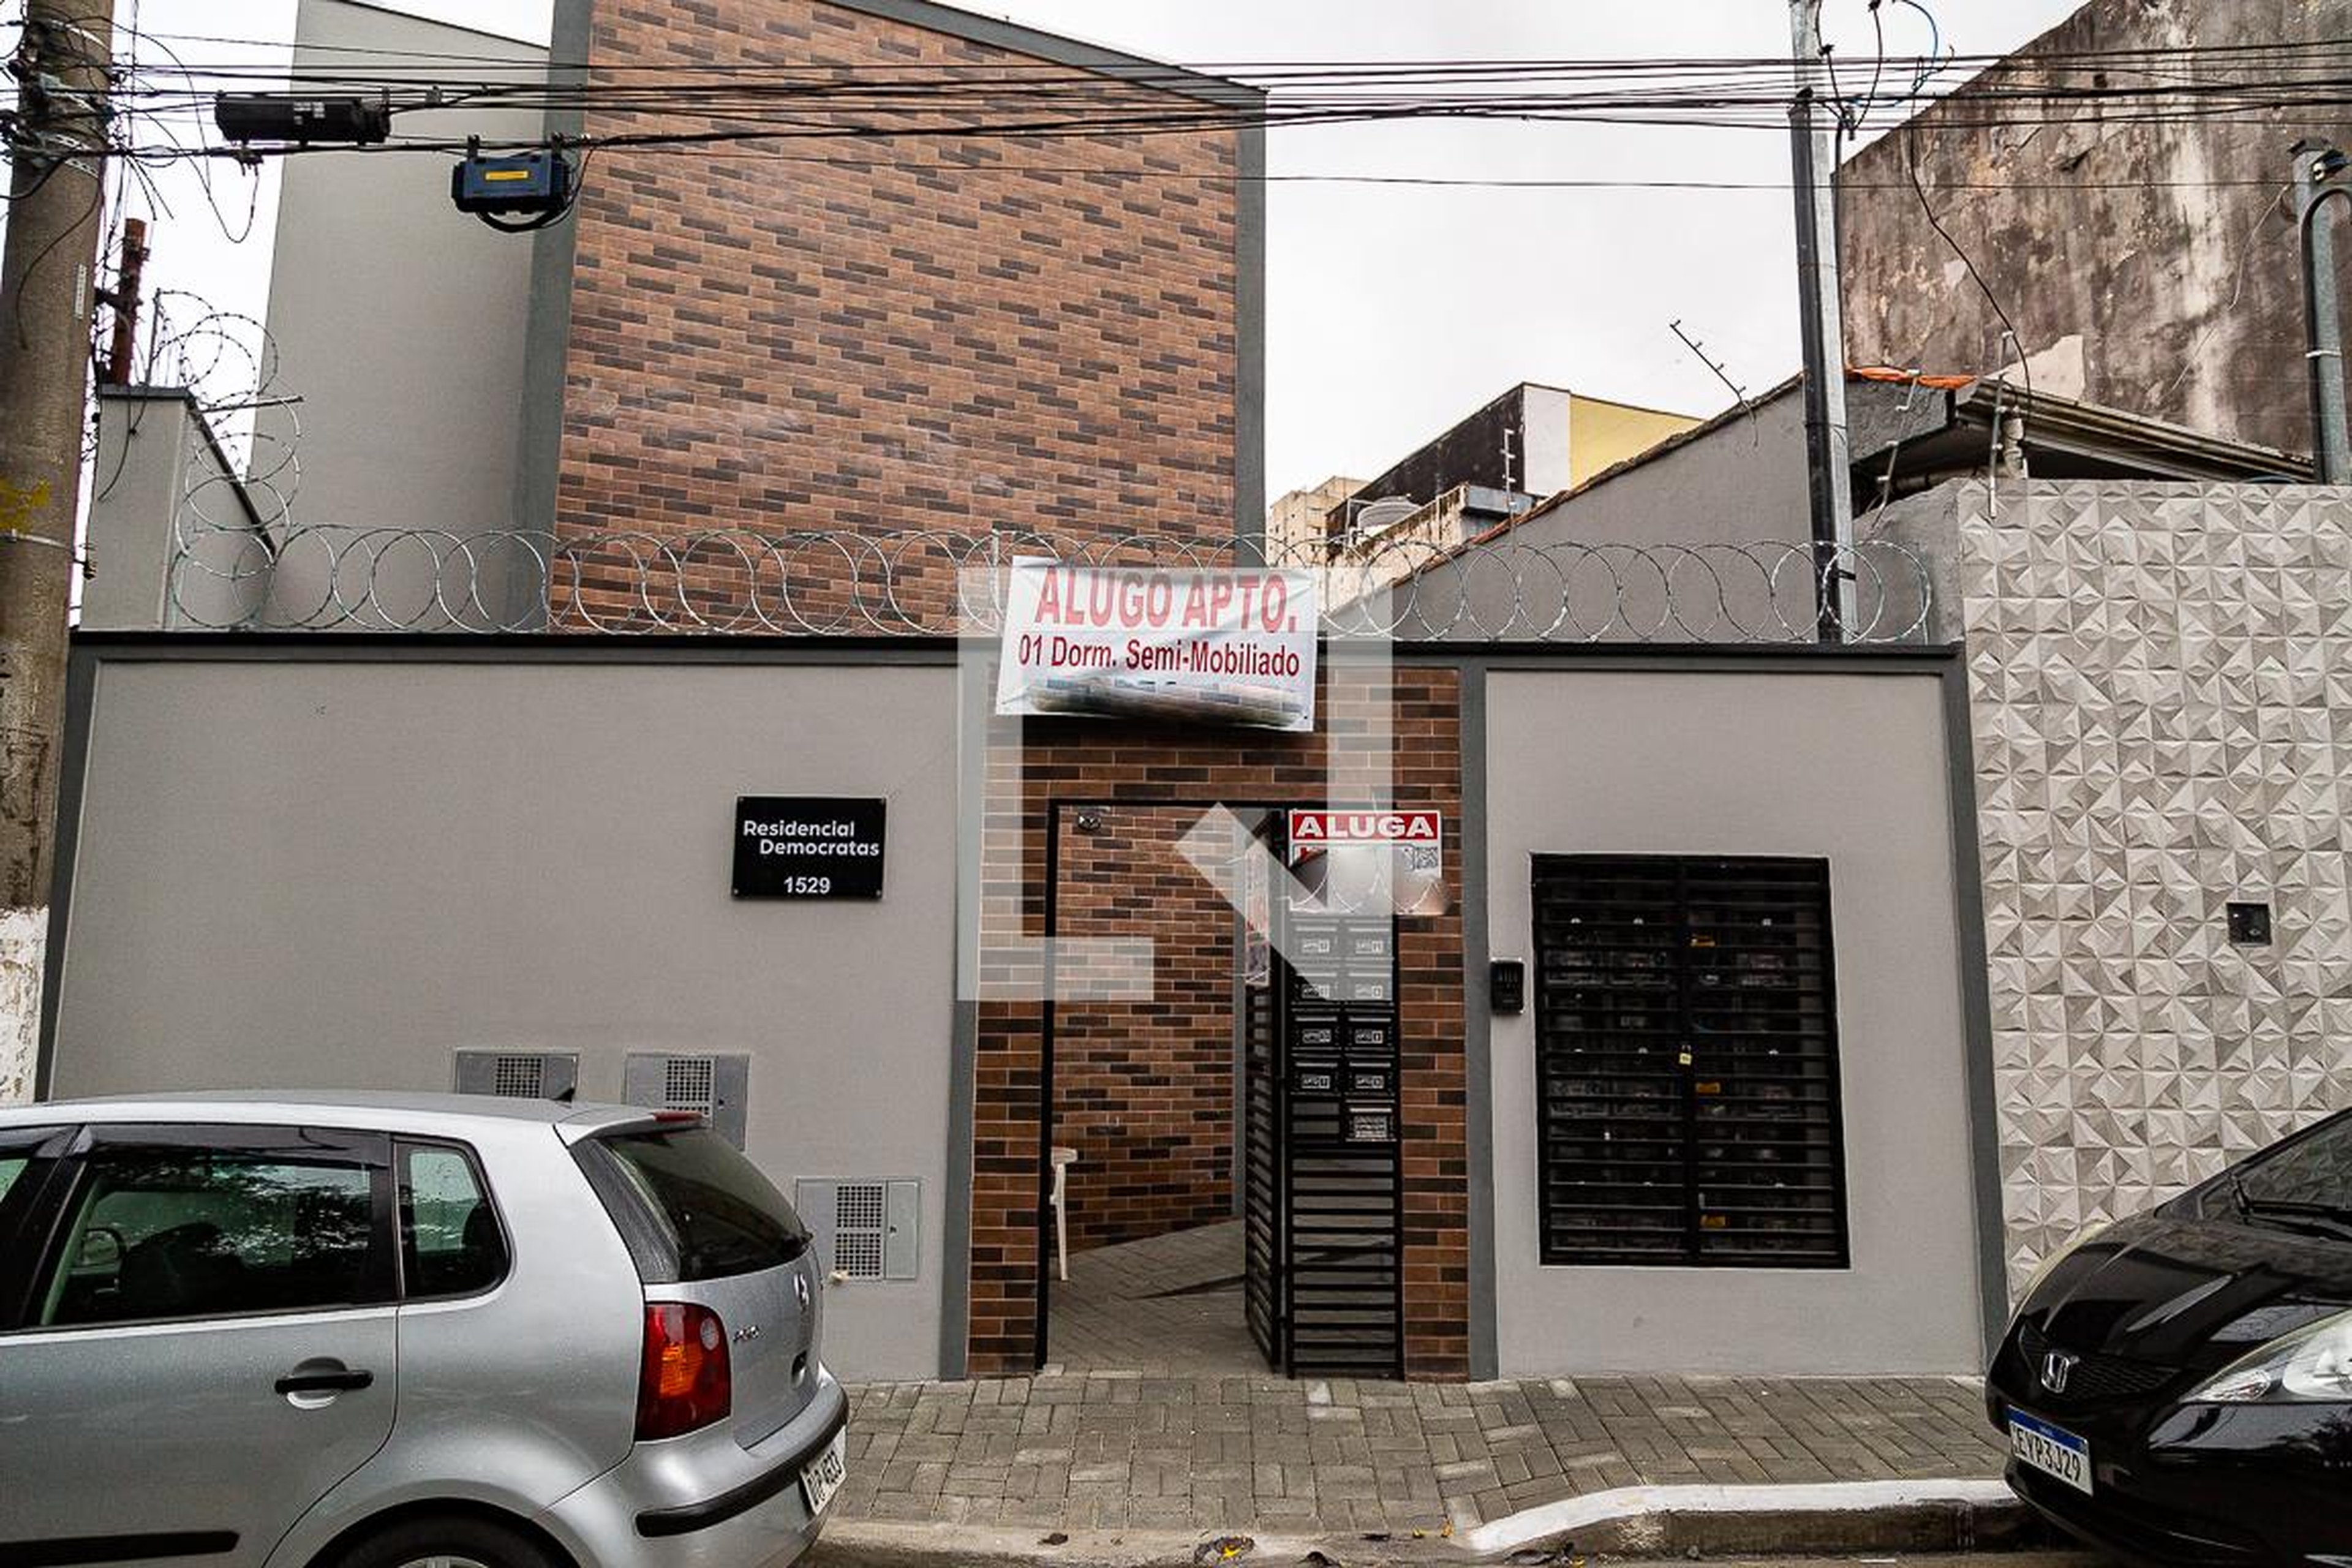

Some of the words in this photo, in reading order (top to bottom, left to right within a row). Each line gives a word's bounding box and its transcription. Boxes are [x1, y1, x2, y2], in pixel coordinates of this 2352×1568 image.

[1035, 565, 1172, 628] ALUGO
[1182, 574, 1296, 633] APTO.
[1019, 635, 1042, 665] 01
[1051, 637, 1116, 666] Dorm.
[1126, 639, 1299, 676] Semi-Mobiliado
[743, 820, 854, 837] Residencial
[1295, 815, 1434, 838] ALUGA
[760, 839, 880, 856] Democratas
[783, 876, 831, 894] 1529
